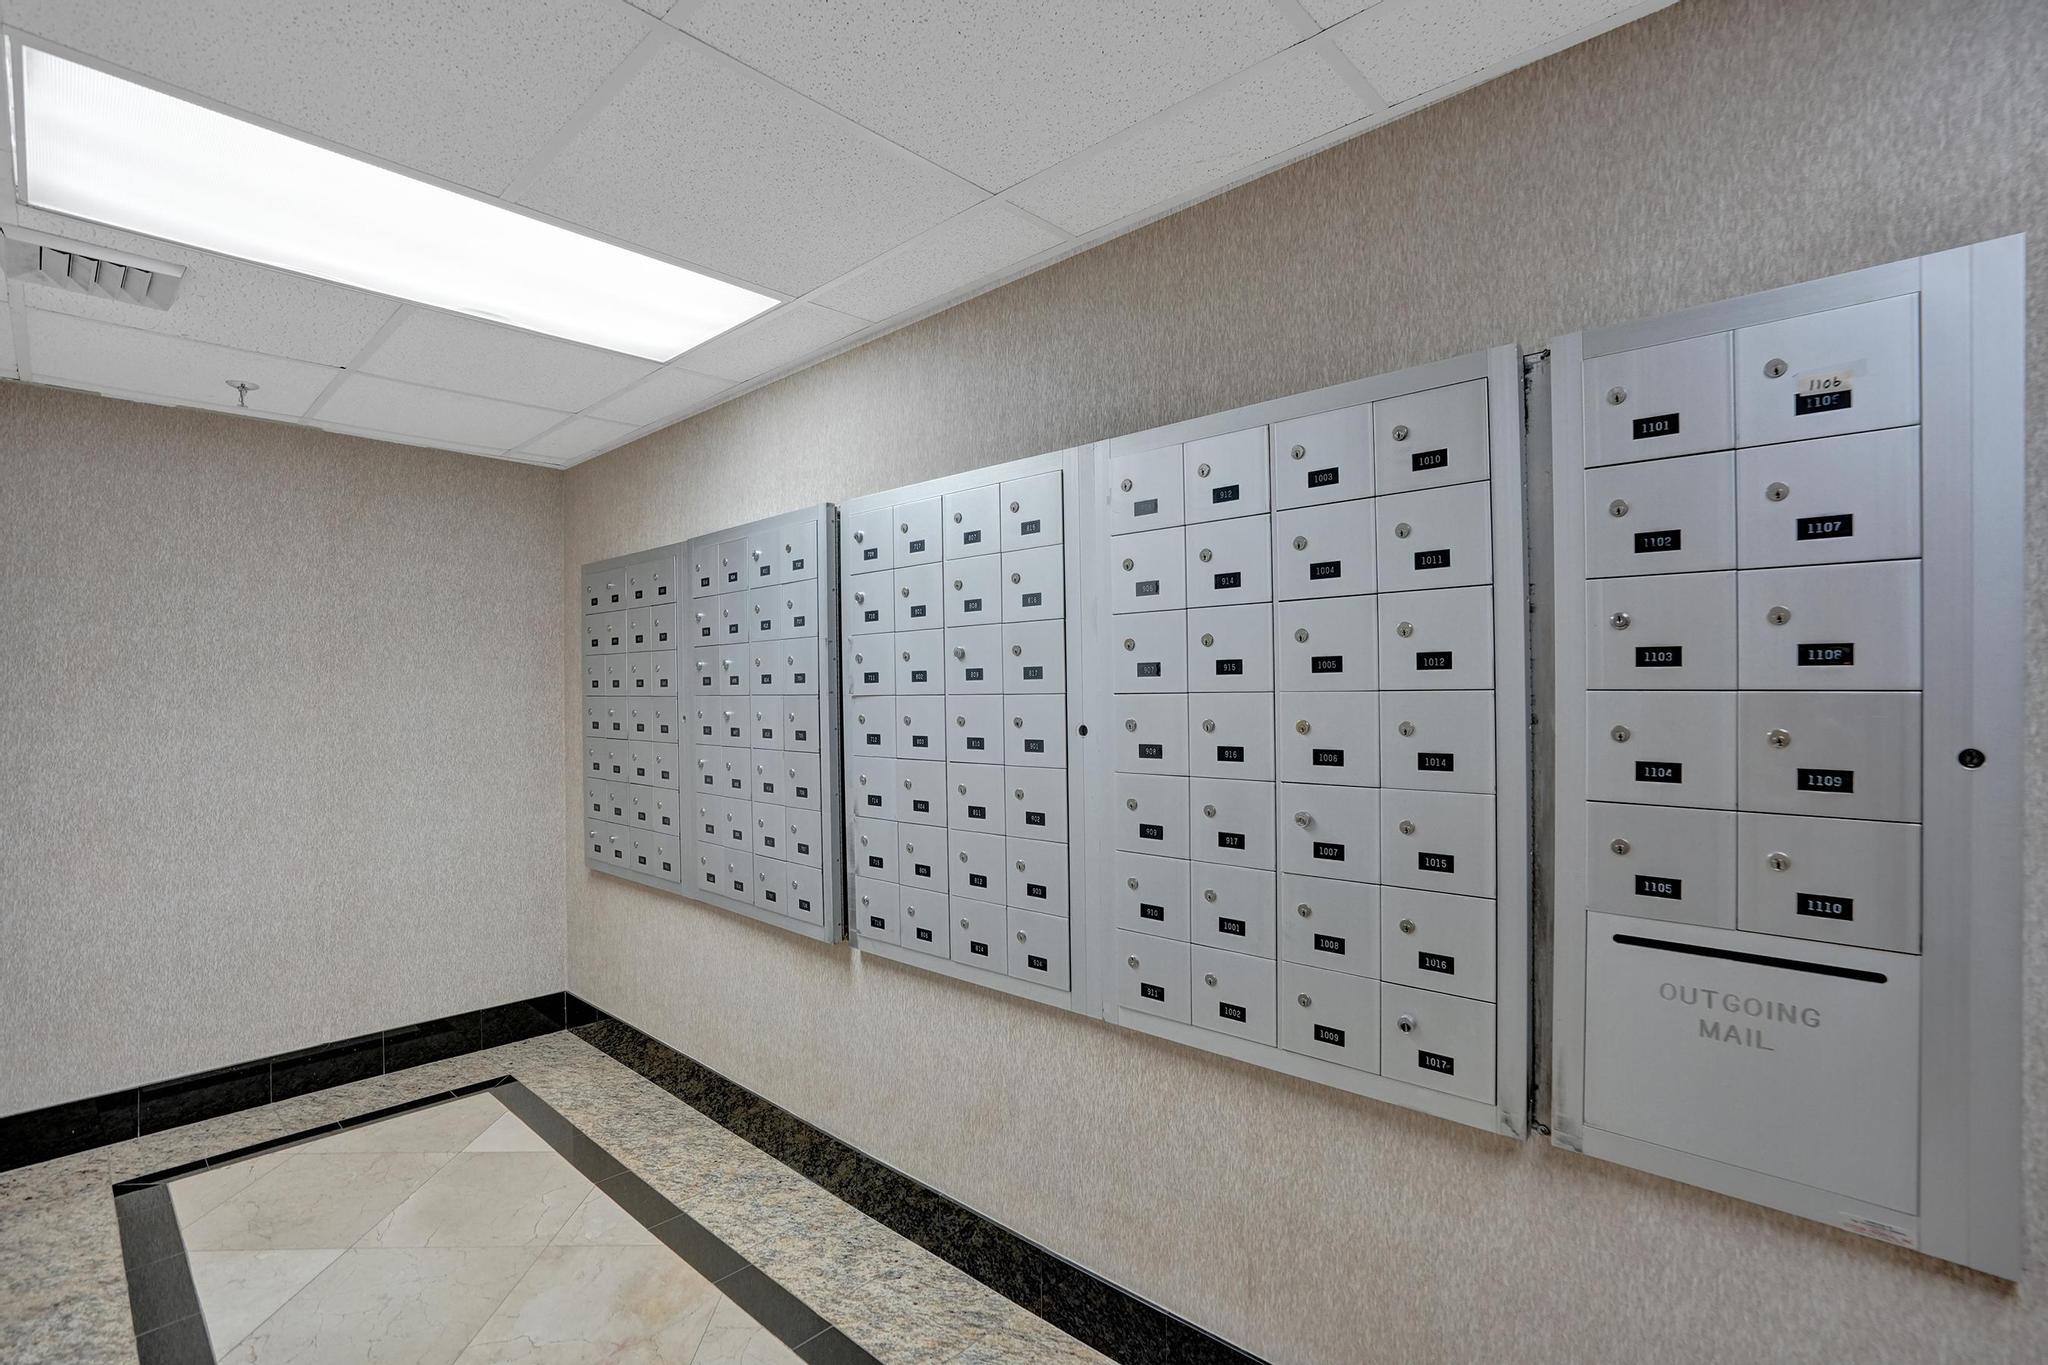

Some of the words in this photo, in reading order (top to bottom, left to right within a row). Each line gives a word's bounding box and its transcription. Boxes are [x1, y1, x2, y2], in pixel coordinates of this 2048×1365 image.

[1809, 376, 1842, 391] 1106
[1642, 420, 1669, 433] 1101
[1419, 454, 1441, 466] 1010
[1314, 472, 1333, 483] 1003
[1219, 489, 1233, 499] 912
[1808, 521, 1842, 534] 1107
[1644, 536, 1672, 547] 1102
[1422, 555, 1442, 565] 1011
[1316, 566, 1335, 575] 1004
[1221, 577, 1234, 585] 914
[1644, 652, 1673, 662] 1103
[1808, 649, 1842, 660] 1108
[1223, 663, 1236, 671] 915
[1318, 660, 1337, 669] 1005
[1424, 657, 1445, 667] 1012
[1143, 666, 1155, 674] 907
[1224, 750, 1238, 759] 916
[1319, 753, 1338, 763] 1006
[1425, 757, 1446, 767] 1014
[1645, 767, 1672, 777] 1104
[1808, 775, 1842, 787] 1109
[1146, 828, 1157, 836] 909
[1225, 836, 1238, 845] 917
[1319, 846, 1338, 856] 1007
[1425, 857, 1447, 868] 1015
[1645, 881, 1672, 894] 1105
[1146, 908, 1158, 917] 910
[1808, 900, 1842, 914] 1110
[1224, 921, 1240, 932] 1001
[1320, 938, 1339, 950] 1008
[1425, 957, 1447, 970] 1016
[1147, 988, 1158, 998] 911
[1659, 982, 1821, 1029] OUTGOING
[1225, 1007, 1241, 1018] 1002
[1320, 1029, 1339, 1042] 1009
[1698, 1018, 1775, 1052] MAIL
[1426, 1056, 1447, 1069] 1017
